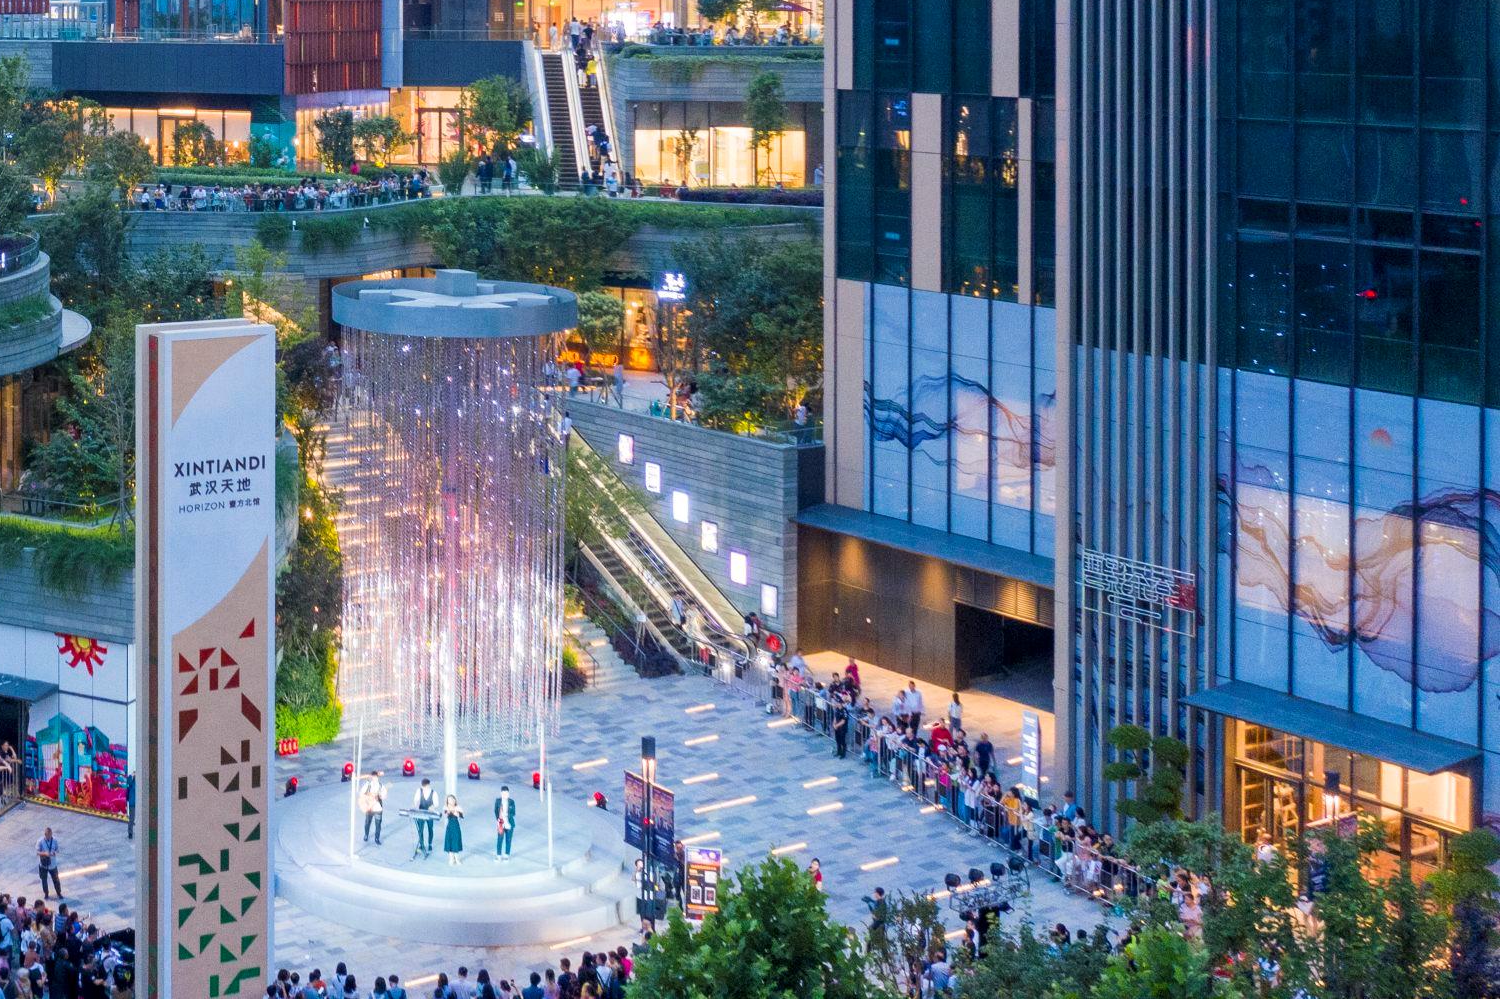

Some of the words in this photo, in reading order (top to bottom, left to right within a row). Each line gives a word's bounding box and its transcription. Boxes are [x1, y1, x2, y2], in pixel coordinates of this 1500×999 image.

[174, 454, 266, 478] XINTIANDI
[189, 476, 251, 497] 武汉天地
[178, 501, 225, 514] HORIZON
